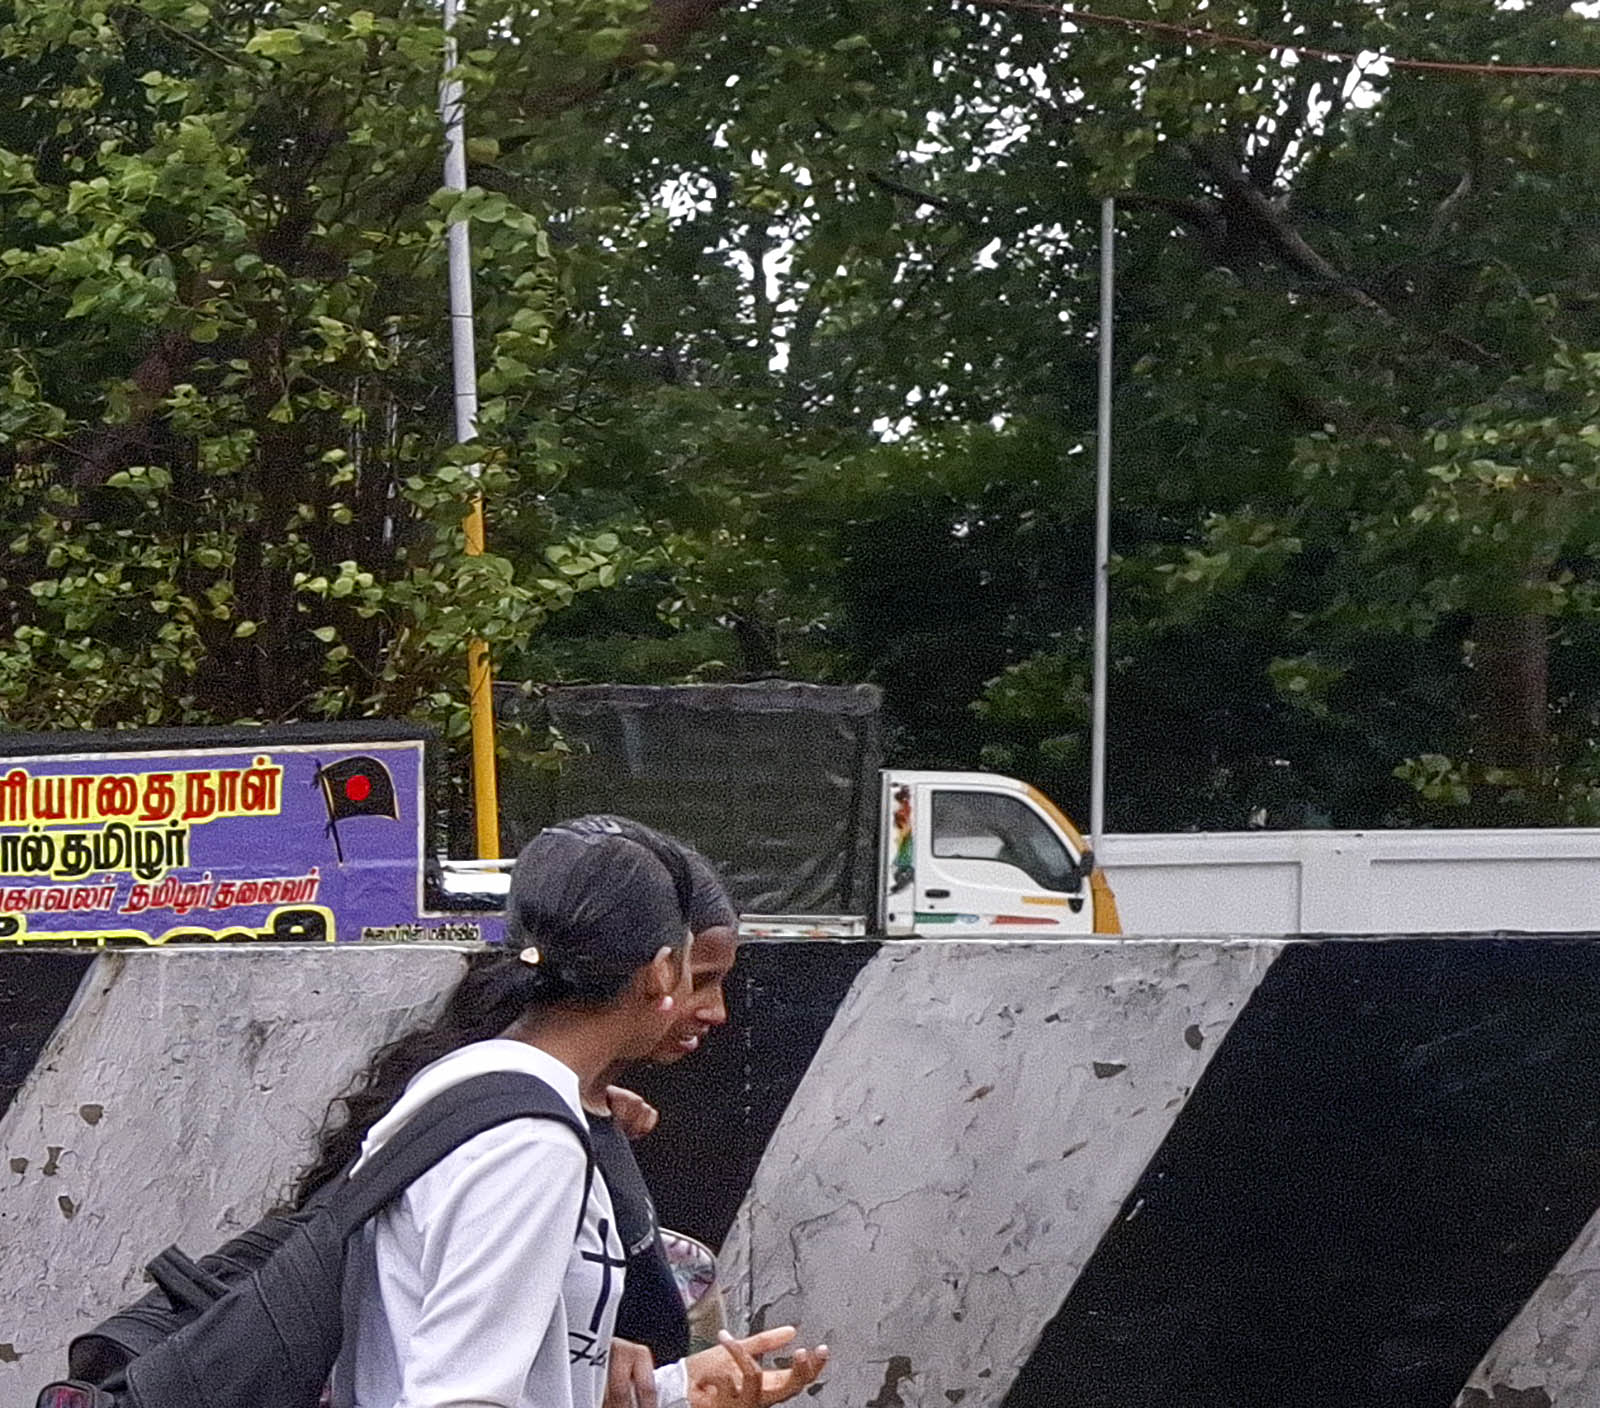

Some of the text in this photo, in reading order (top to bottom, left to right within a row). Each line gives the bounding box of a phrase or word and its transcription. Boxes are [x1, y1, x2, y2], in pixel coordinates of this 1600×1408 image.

[181, 757, 281, 821] நாள்
[54, 818, 187, 880] தமிழர்
[118, 871, 212, 914] தமிழர்
[209, 868, 321, 910] தலைவர்
